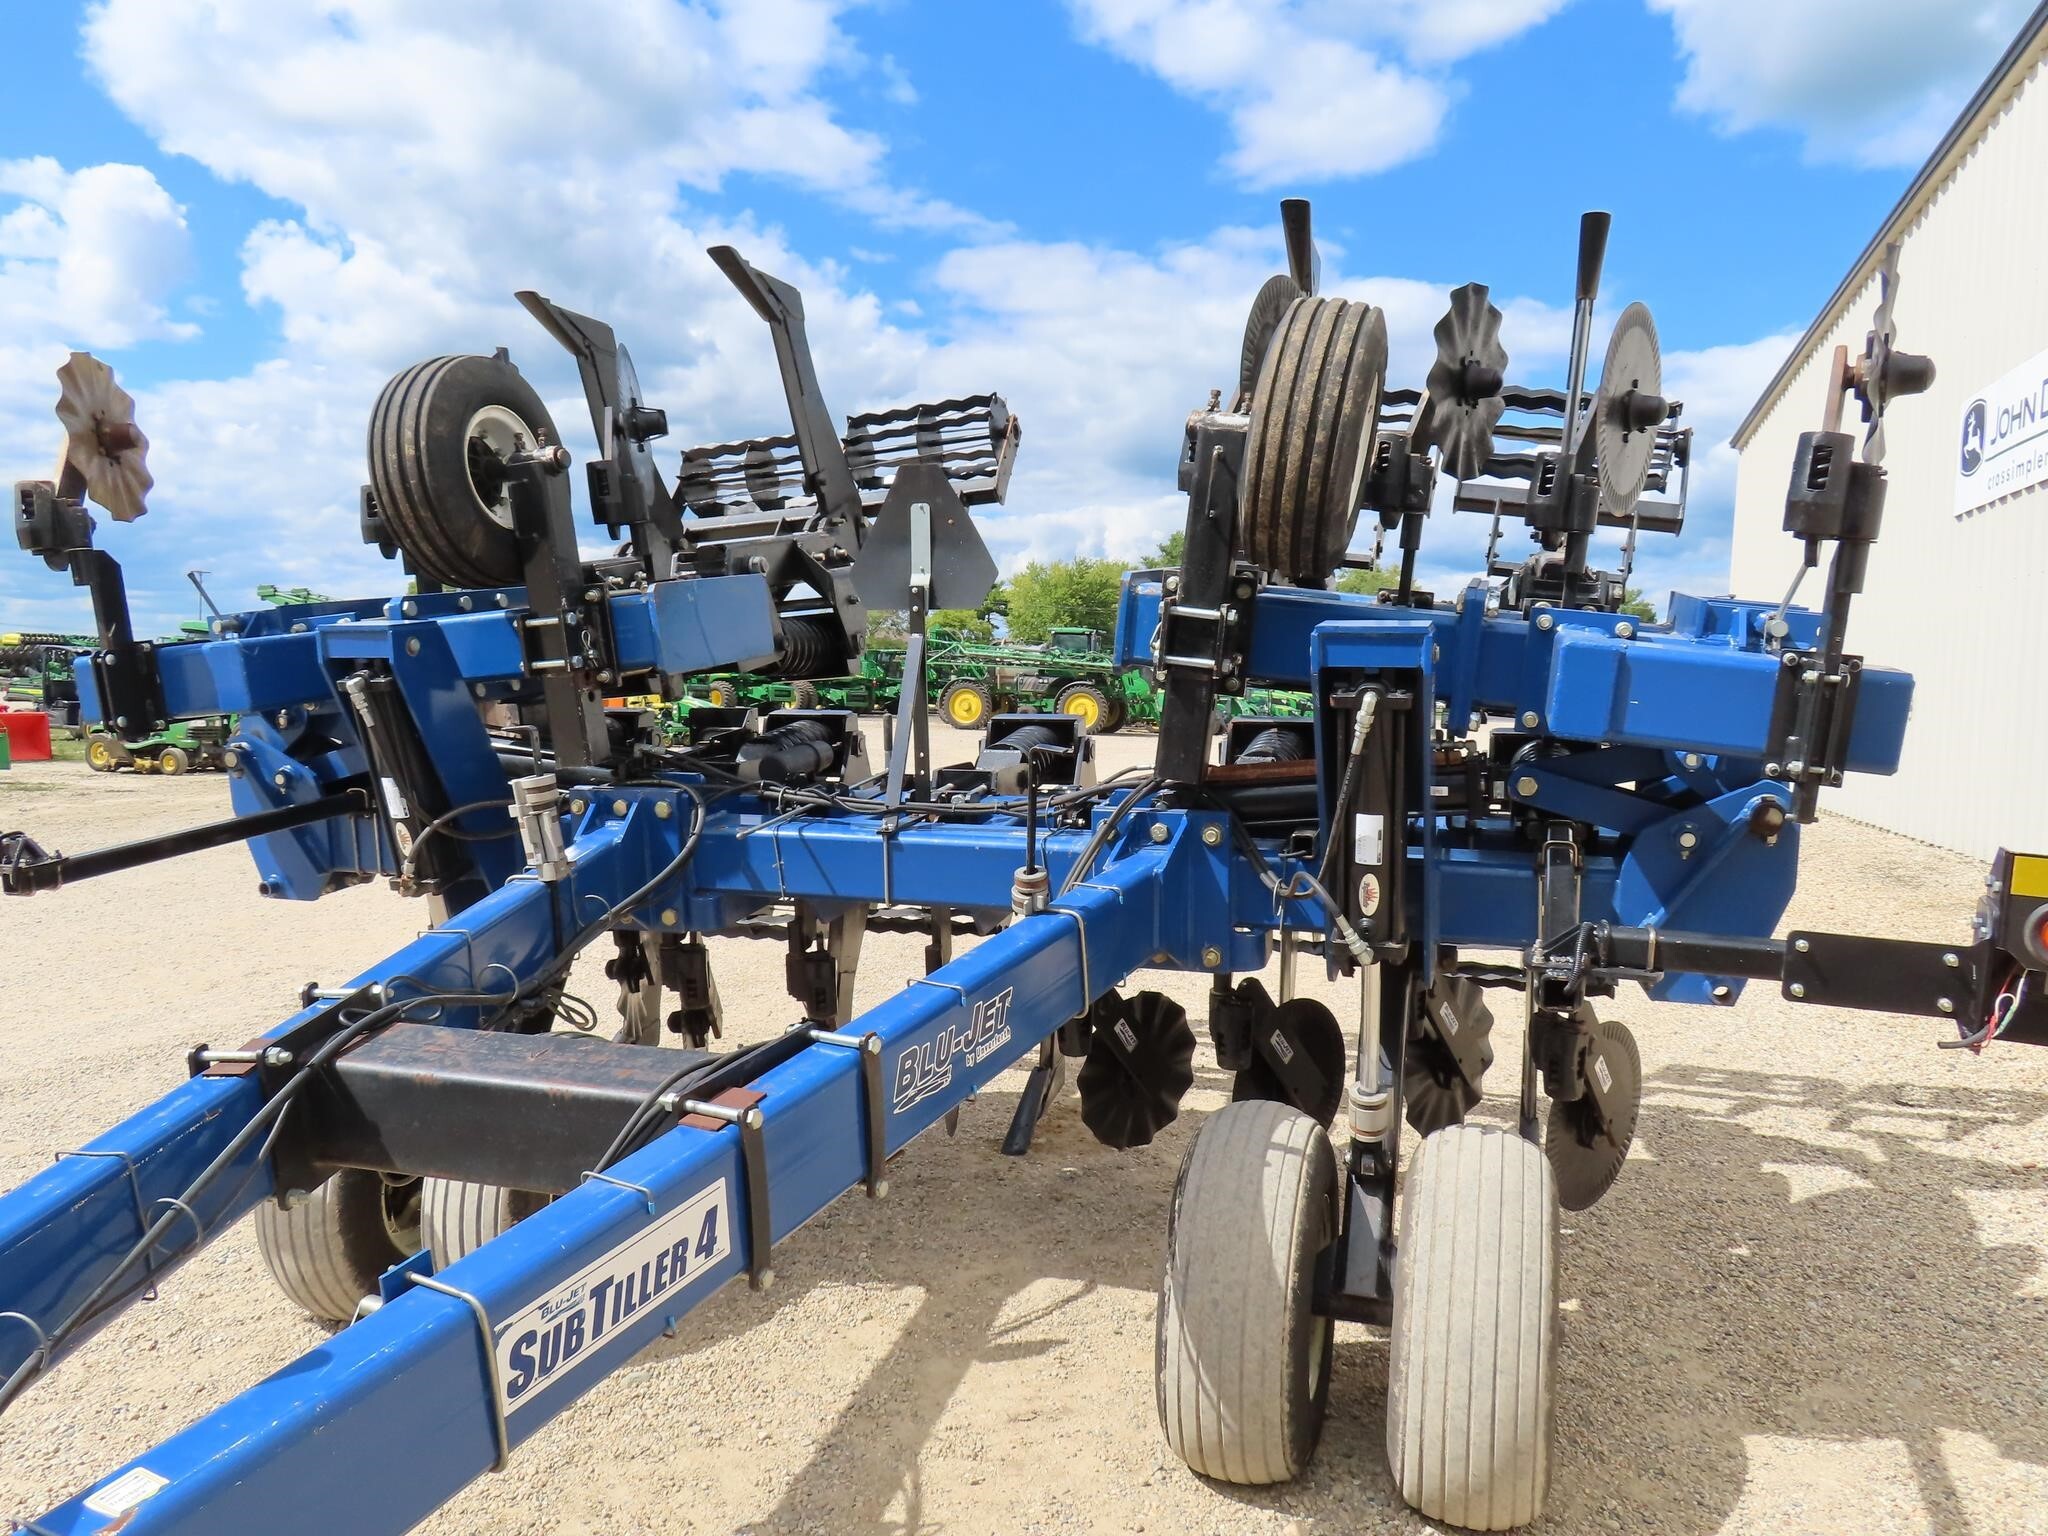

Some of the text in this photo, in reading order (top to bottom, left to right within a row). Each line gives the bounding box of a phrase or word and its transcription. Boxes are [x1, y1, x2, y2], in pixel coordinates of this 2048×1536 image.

[1990, 391, 2038, 446] JOHN
[893, 986, 1013, 1103] BLU-JET
[694, 1204, 720, 1260] 4
[540, 1281, 588, 1321] BLU-JET
